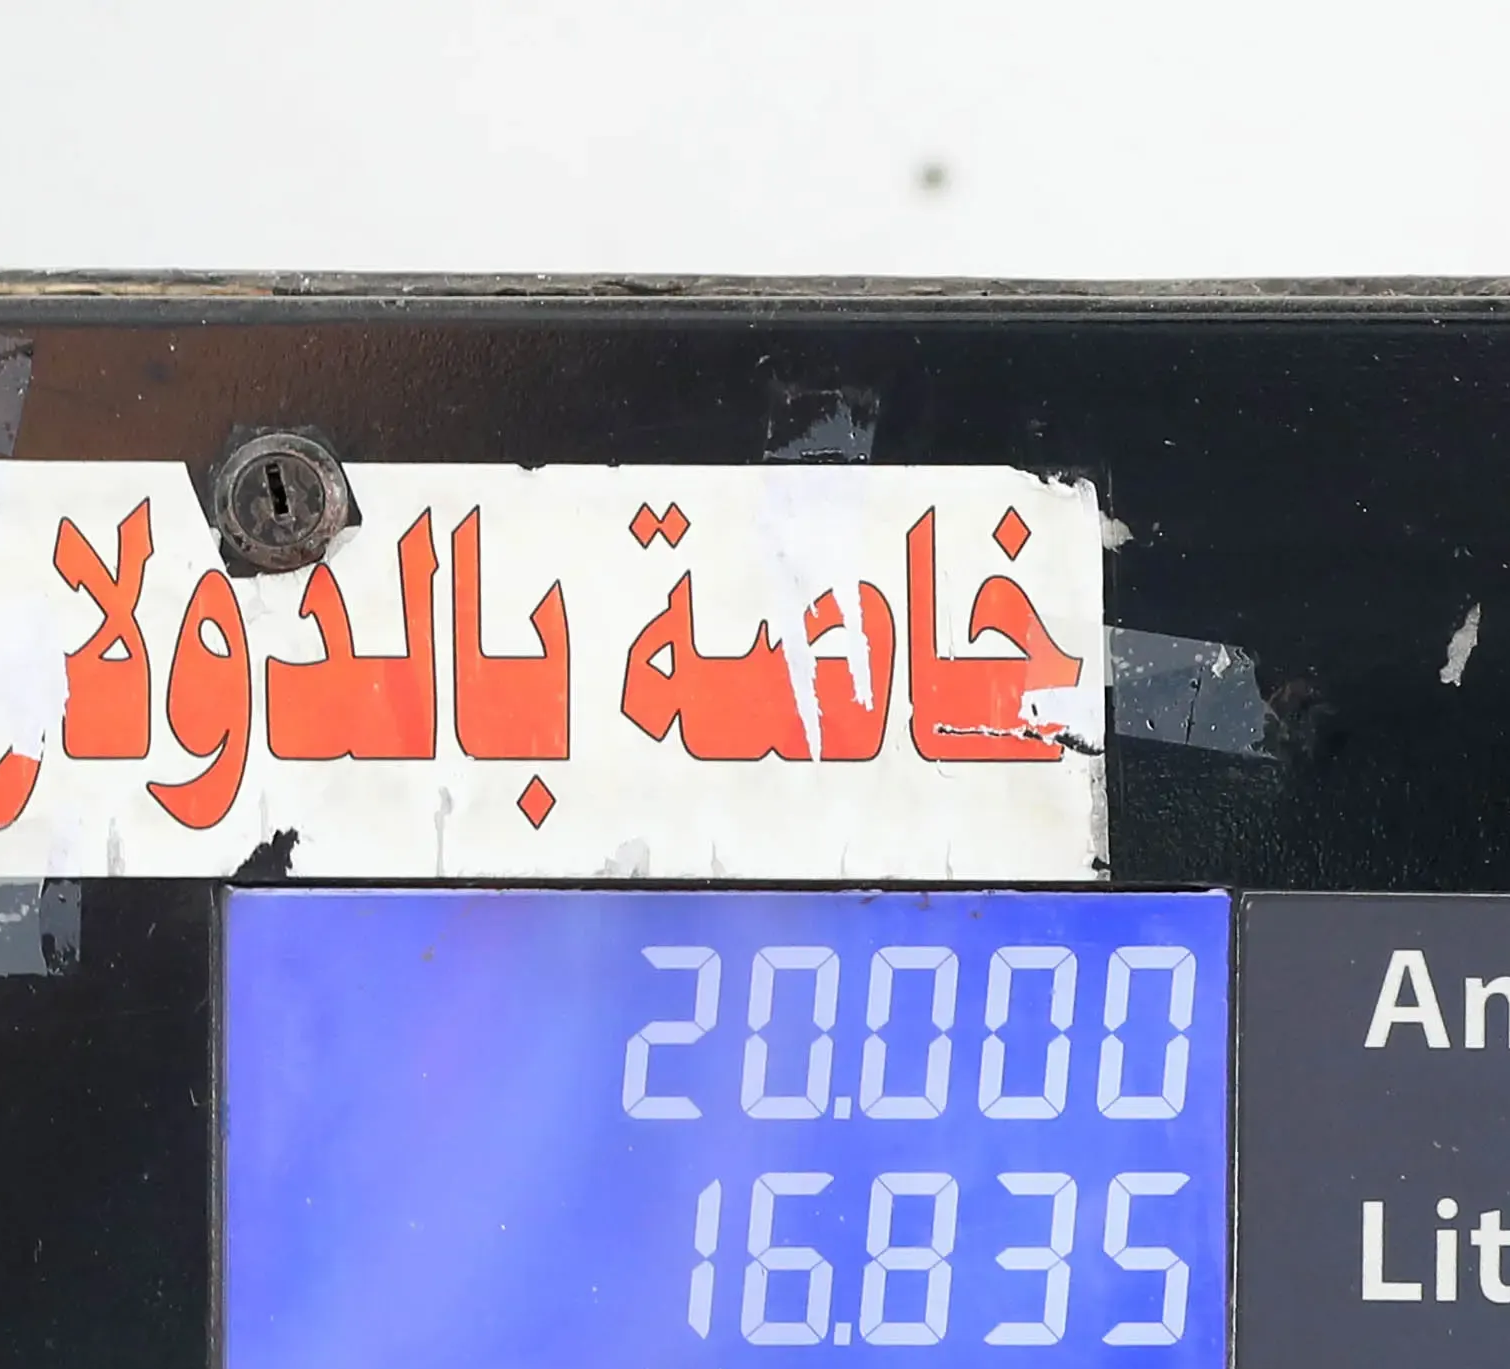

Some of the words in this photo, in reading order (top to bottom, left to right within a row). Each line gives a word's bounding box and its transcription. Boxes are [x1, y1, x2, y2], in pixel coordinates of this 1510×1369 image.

[621, 501, 1083, 763] خاصة
[621, 945, 1196, 1120] 20.000
[687, 1171, 1191, 1345] 16.835
